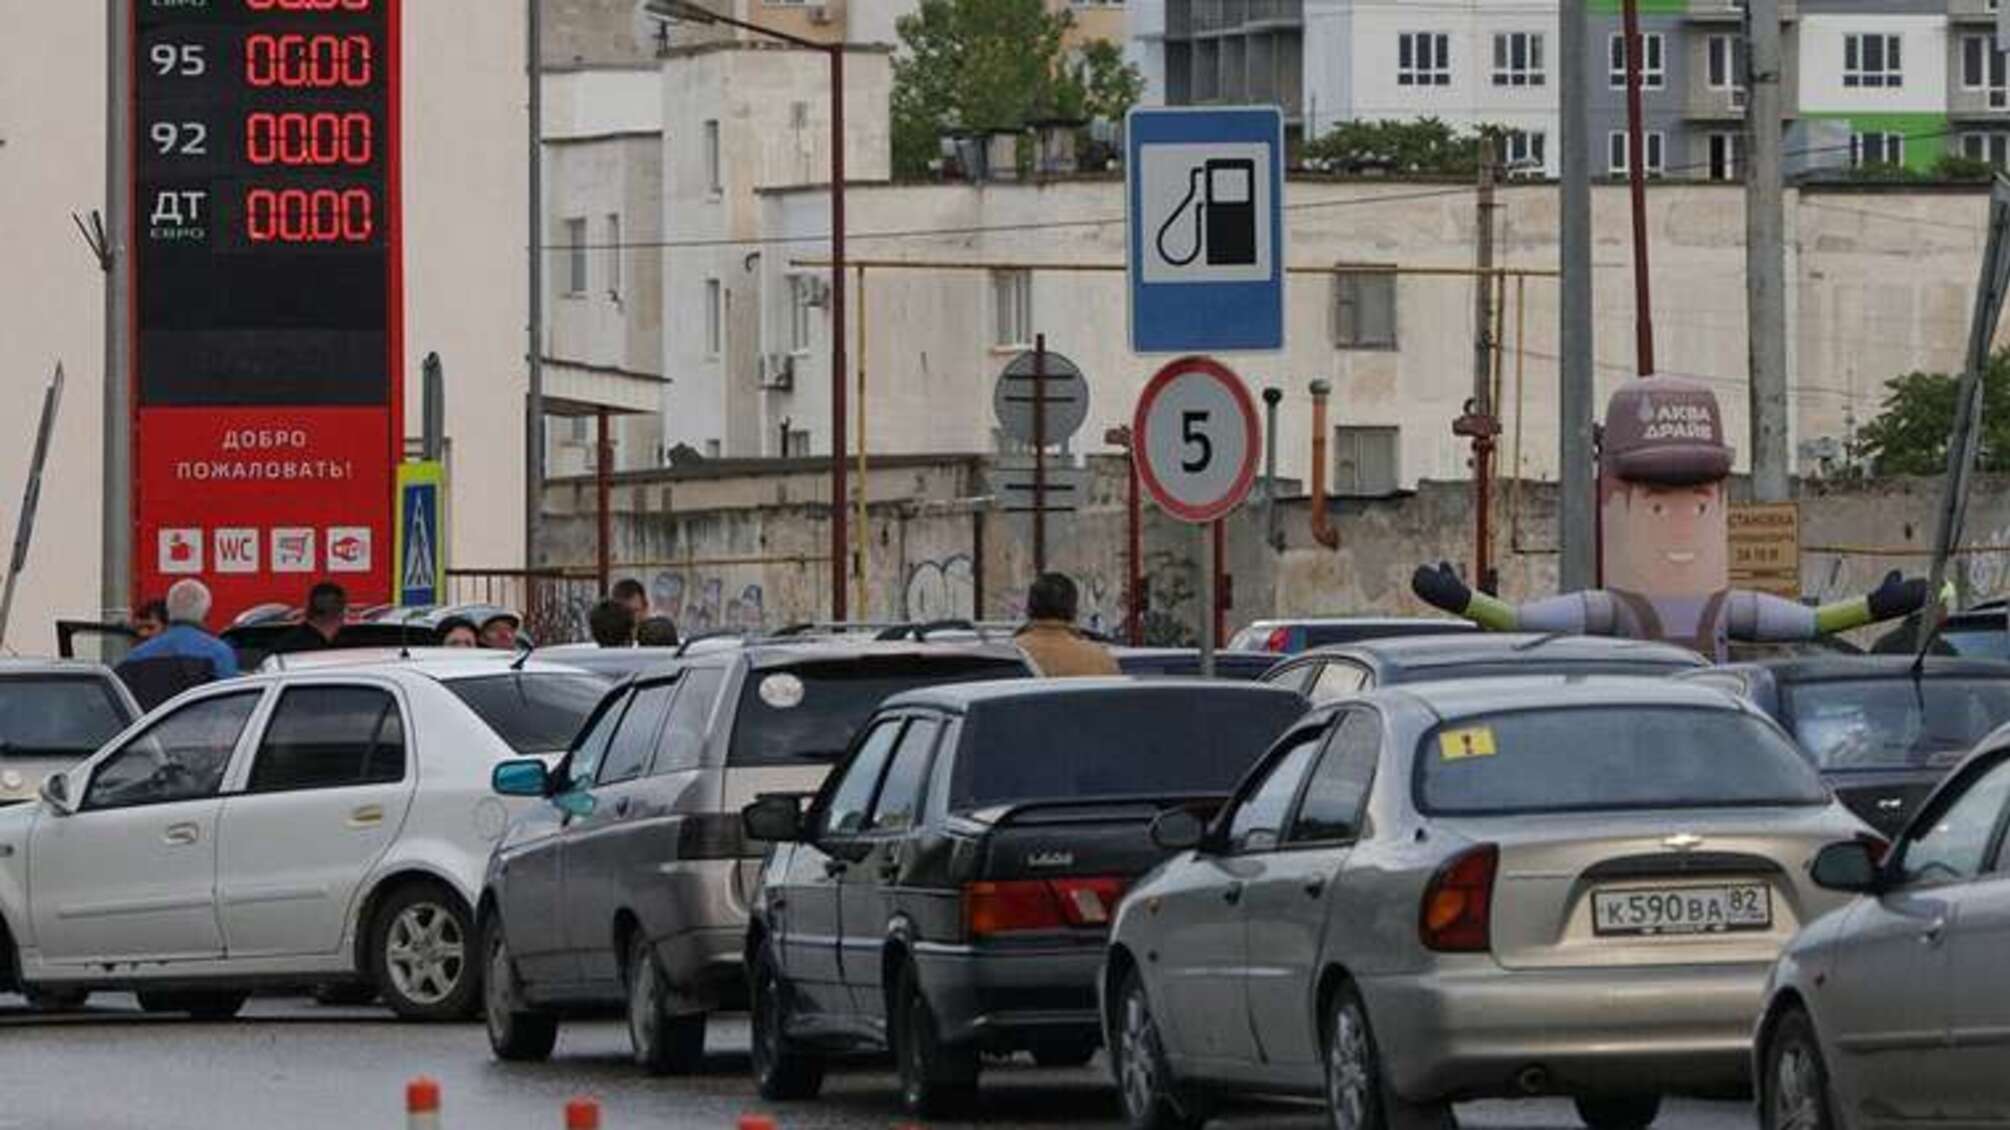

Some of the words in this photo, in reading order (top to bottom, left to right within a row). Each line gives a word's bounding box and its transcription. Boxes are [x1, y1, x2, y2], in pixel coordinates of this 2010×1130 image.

[151, 44, 206, 75] 95
[246, 35, 371, 87] 00.00
[151, 122, 207, 154] 92
[247, 112, 372, 164] 00.00
[151, 191, 207, 226] ДТ
[247, 189, 372, 241] 00.00
[1657, 405, 1712, 422] АКВА
[221, 430, 307, 451] ДОБРО
[1181, 411, 1213, 474] 5
[176, 461, 351, 481] ПОЖАЛОВАТЬ!
[218, 536, 252, 562] WC
[1730, 889, 1758, 912] 82
